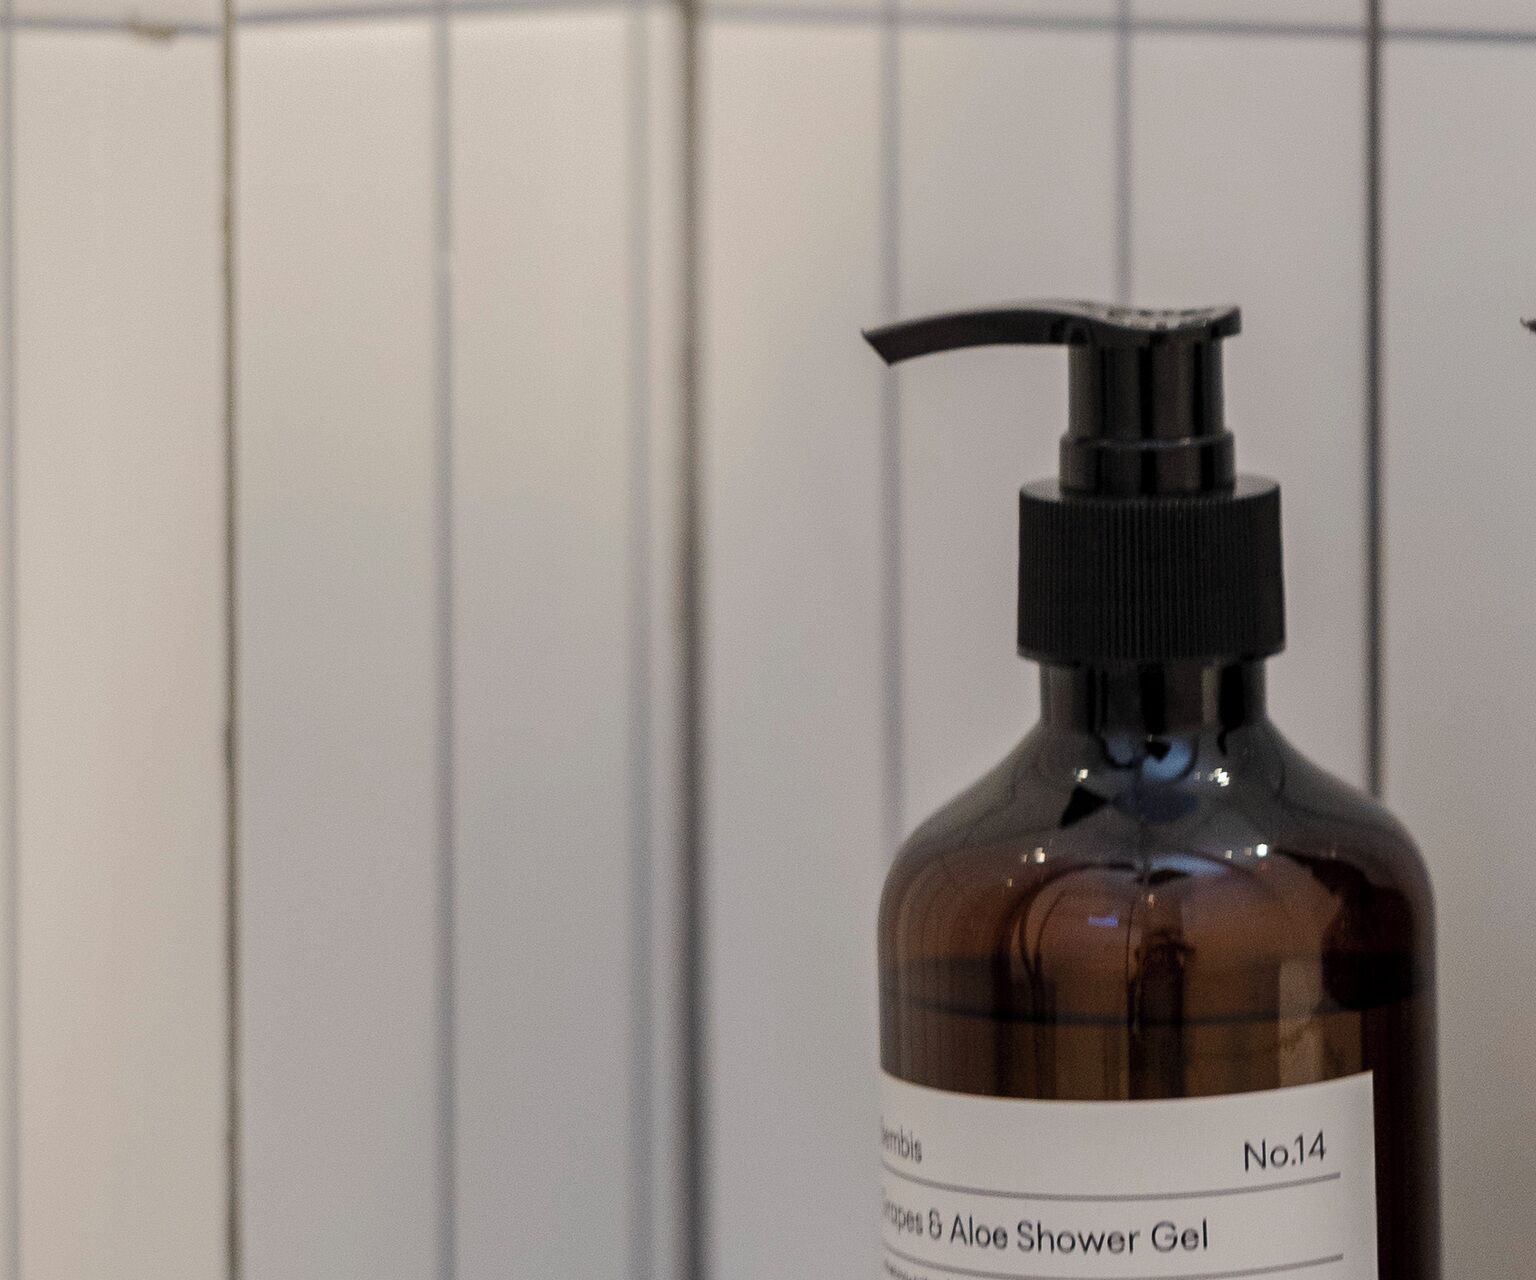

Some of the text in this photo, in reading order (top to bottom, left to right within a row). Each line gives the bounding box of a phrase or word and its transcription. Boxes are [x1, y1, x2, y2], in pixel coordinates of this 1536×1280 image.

[1244, 1130, 1326, 1172] No.14
[928, 1208, 943, 1241] &
[950, 1213, 1008, 1250] Aloe
[1017, 1220, 1140, 1254] Shower
[1151, 1218, 1208, 1252] Gel
